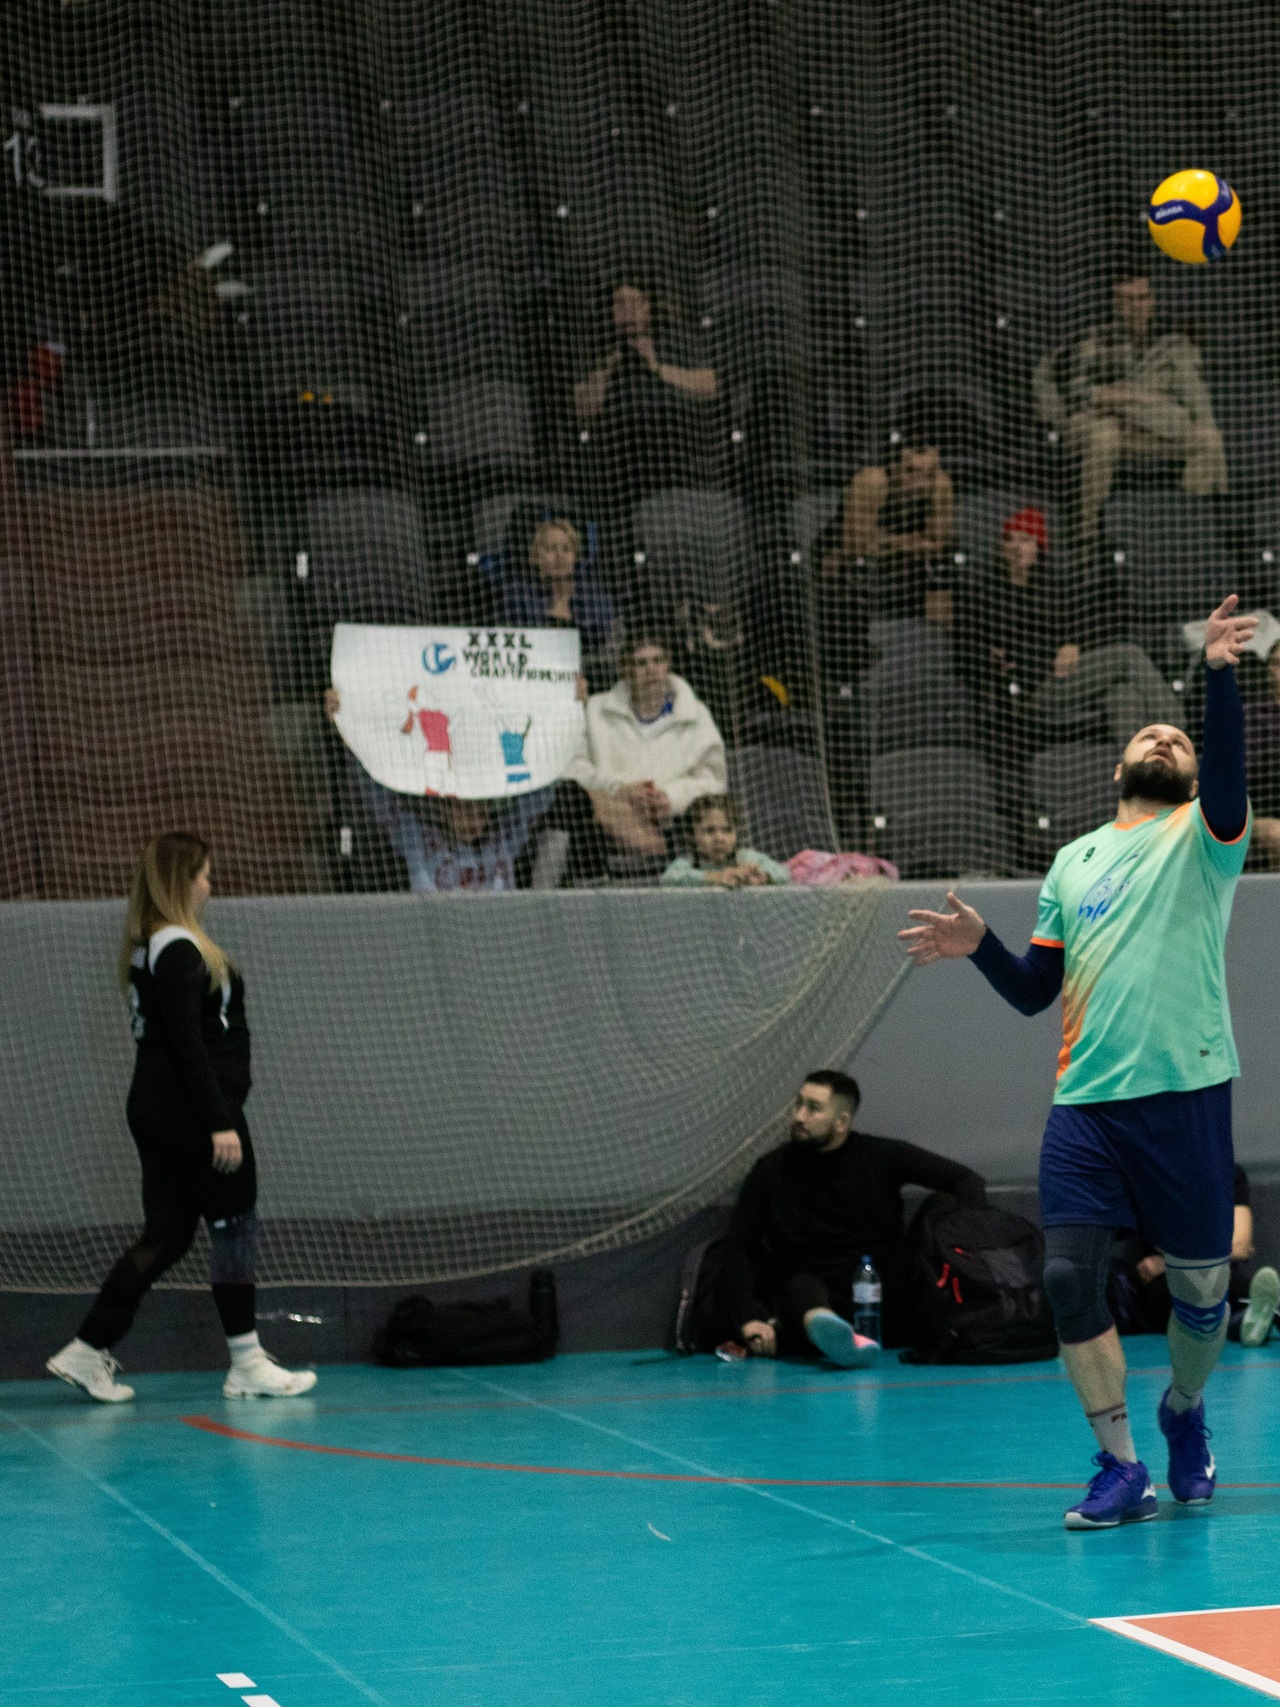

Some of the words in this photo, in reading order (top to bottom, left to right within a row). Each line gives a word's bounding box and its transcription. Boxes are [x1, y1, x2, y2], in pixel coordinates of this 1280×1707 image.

[468, 632, 533, 649] XXXL
[462, 649, 528, 667] WORLD
[1082, 846, 1096, 863] 9
